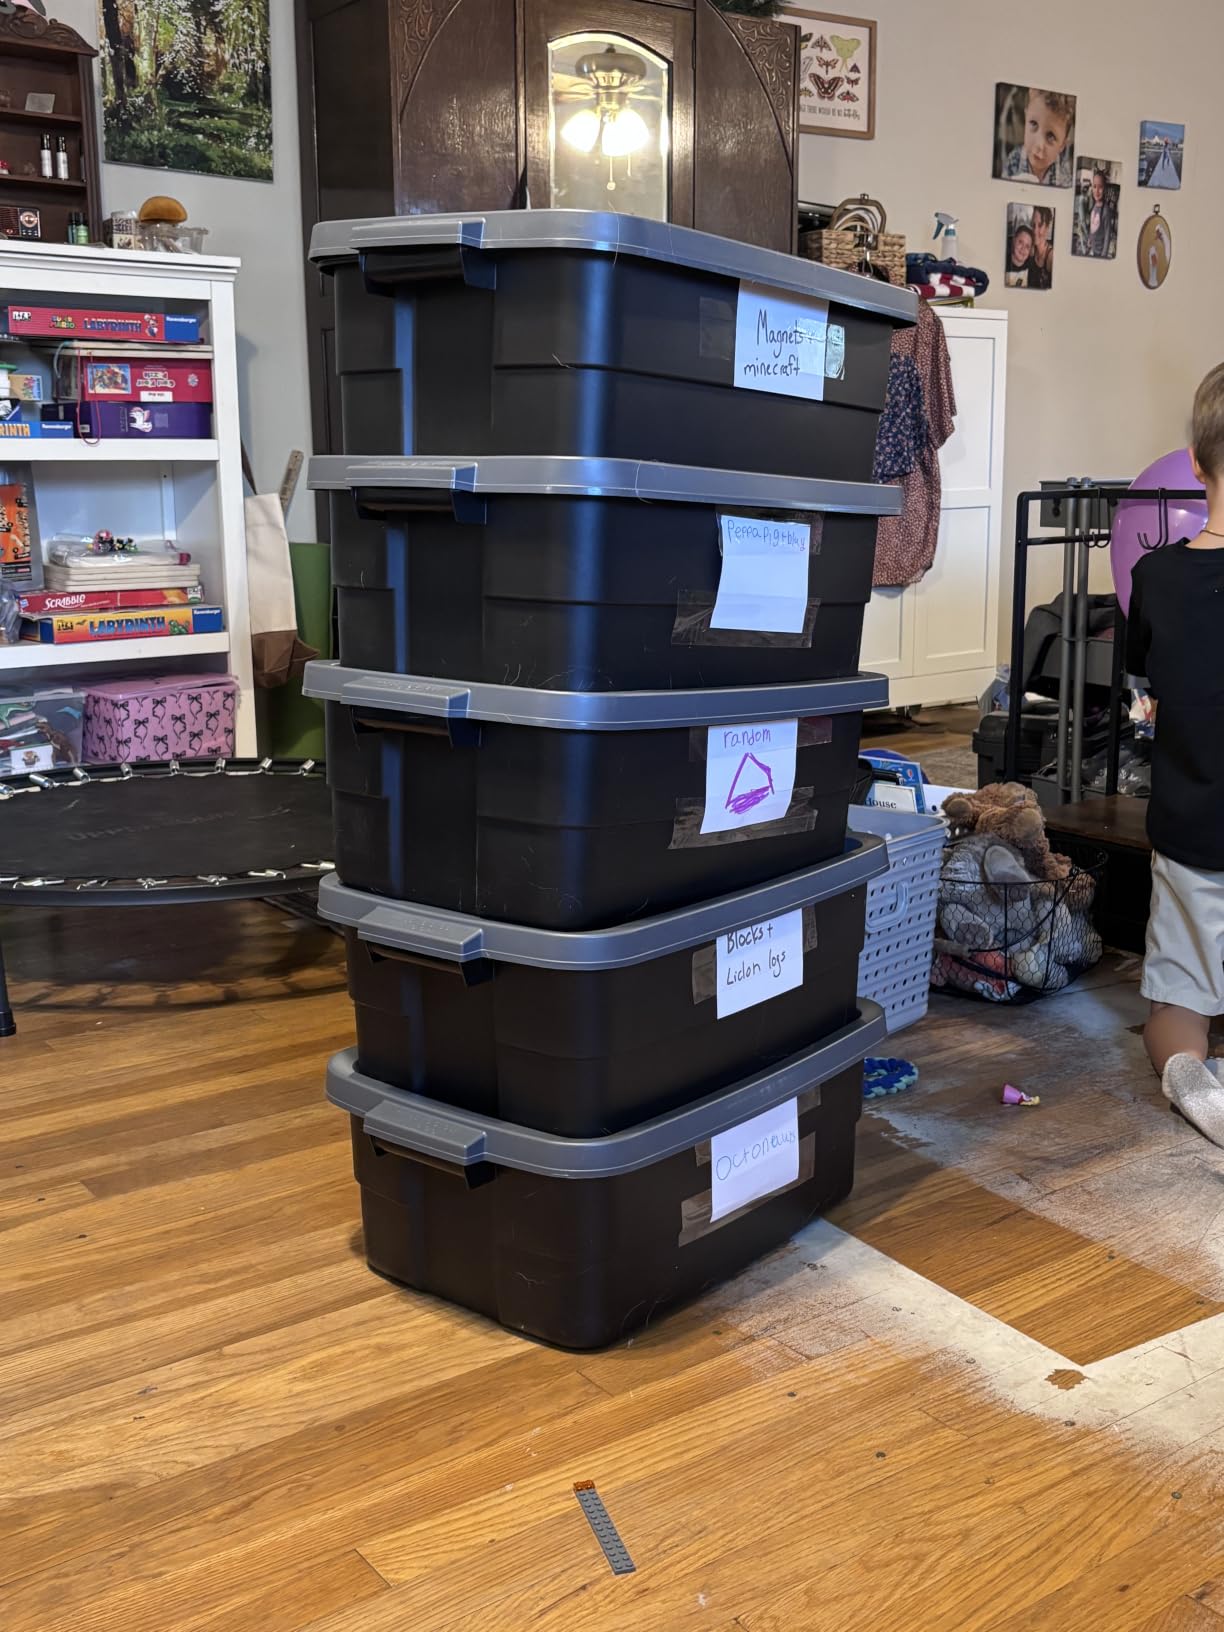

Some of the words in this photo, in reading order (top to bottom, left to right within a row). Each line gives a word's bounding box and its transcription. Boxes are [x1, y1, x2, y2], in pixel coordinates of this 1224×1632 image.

[83, 318, 142, 333] LABYRINTH
[743, 354, 800, 377] minecraft
[727, 519, 762, 543] Peppa
[89, 616, 165, 635] LABYRINTH
[724, 728, 771, 748] random
